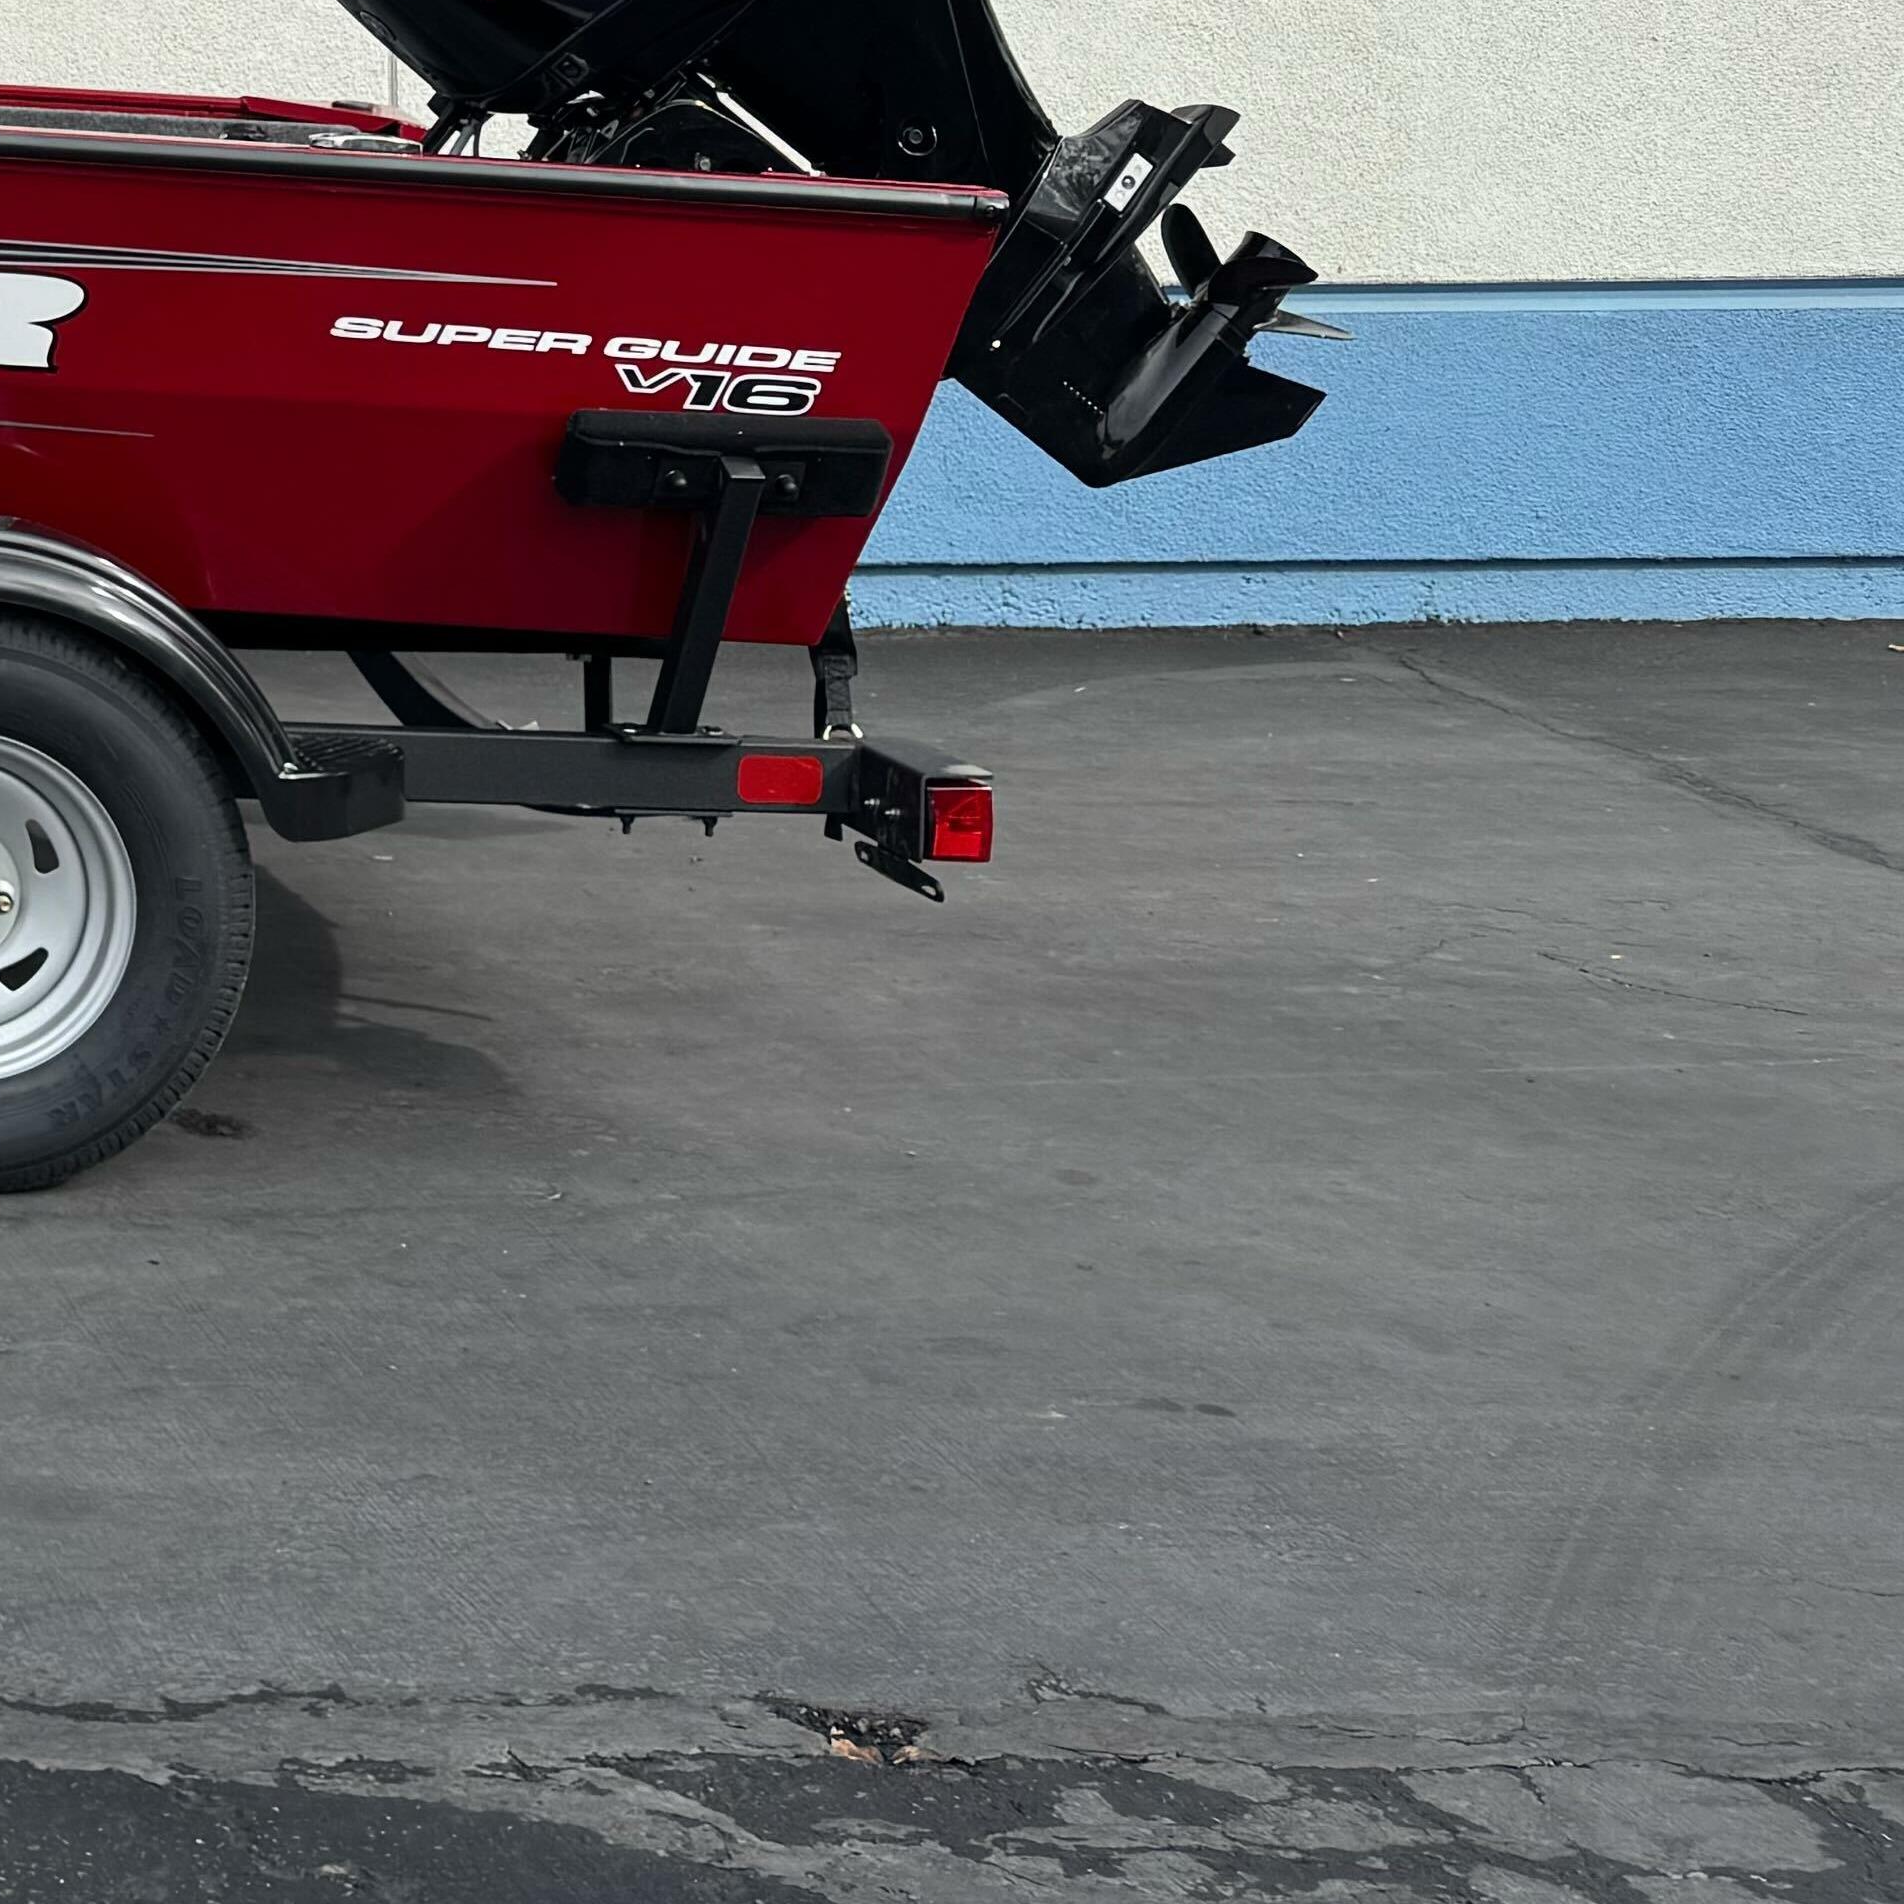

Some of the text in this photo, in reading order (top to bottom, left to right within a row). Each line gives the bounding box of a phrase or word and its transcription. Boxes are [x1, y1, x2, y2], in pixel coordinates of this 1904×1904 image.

[329, 316, 842, 372] SUPER GUIDE
[615, 363, 823, 416] V16
